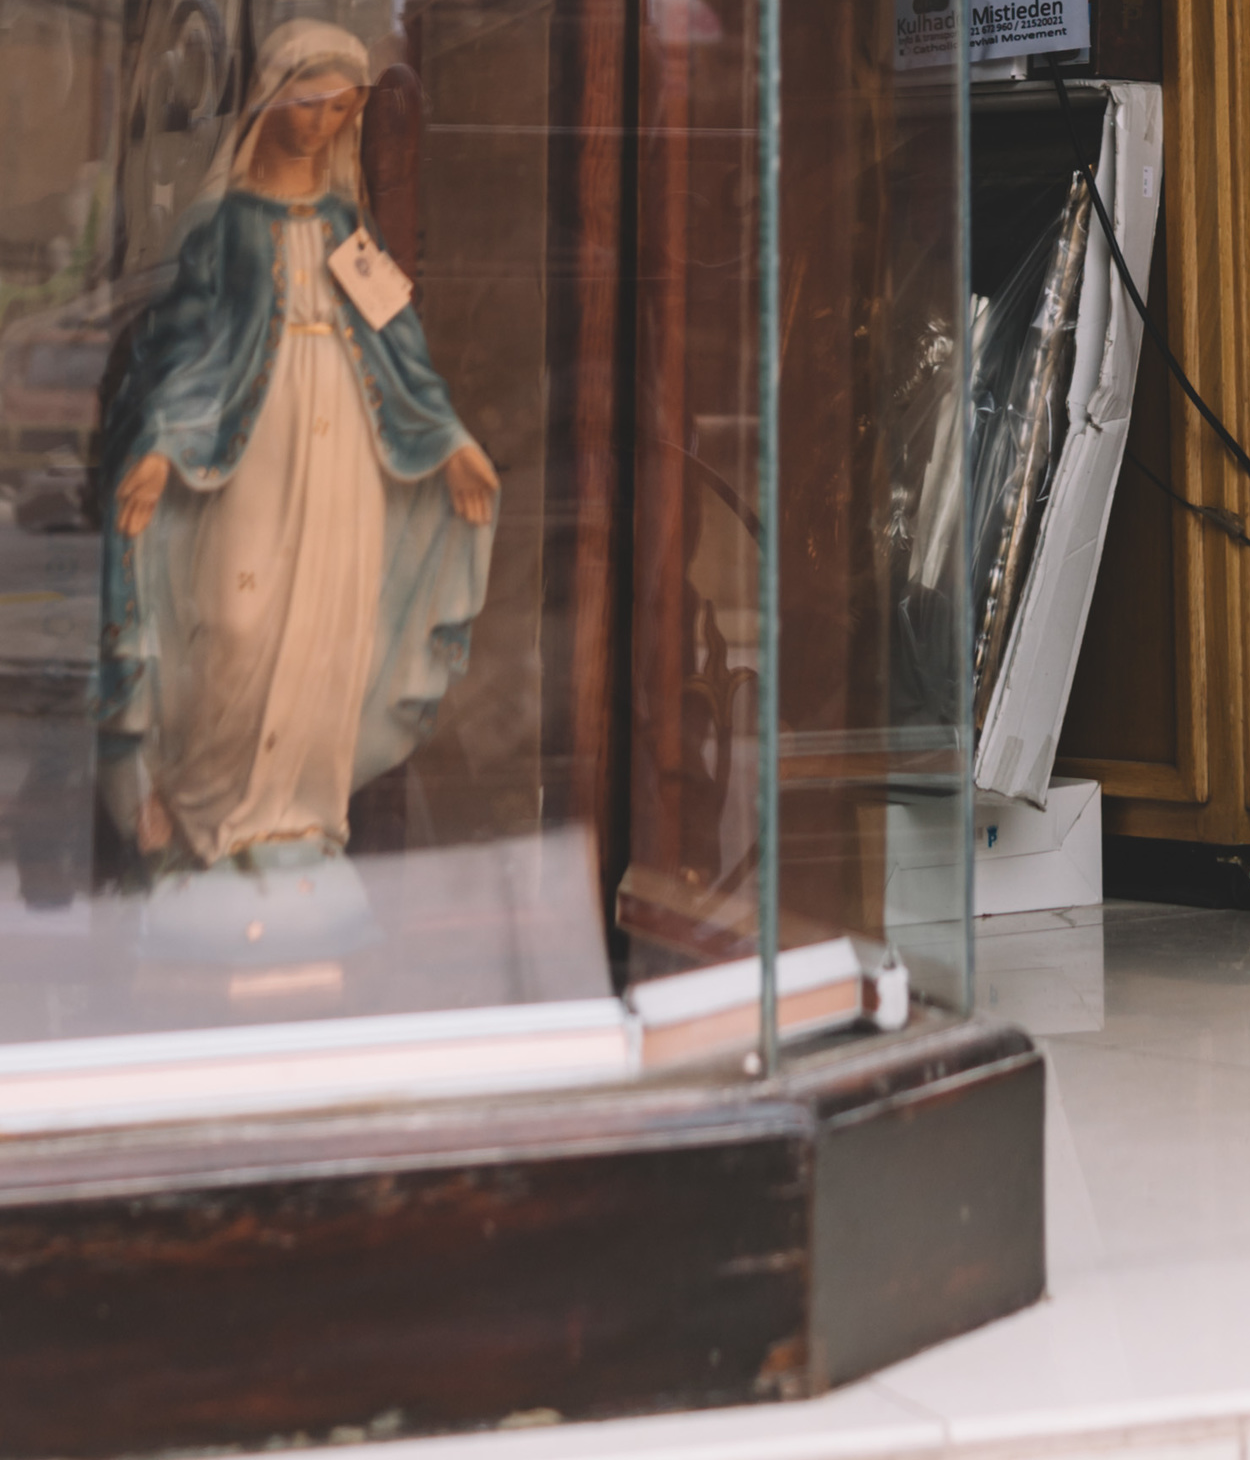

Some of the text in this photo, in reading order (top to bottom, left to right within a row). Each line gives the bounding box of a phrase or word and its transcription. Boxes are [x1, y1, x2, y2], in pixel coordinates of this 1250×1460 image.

[897, 10, 957, 36] Kulhad
[970, 27, 980, 36] 21
[996, 22, 1013, 33] 960
[1021, 17, 1063, 29] 21520021
[913, 42, 958, 54] Catholic
[1001, 28, 1067, 43] Movement
